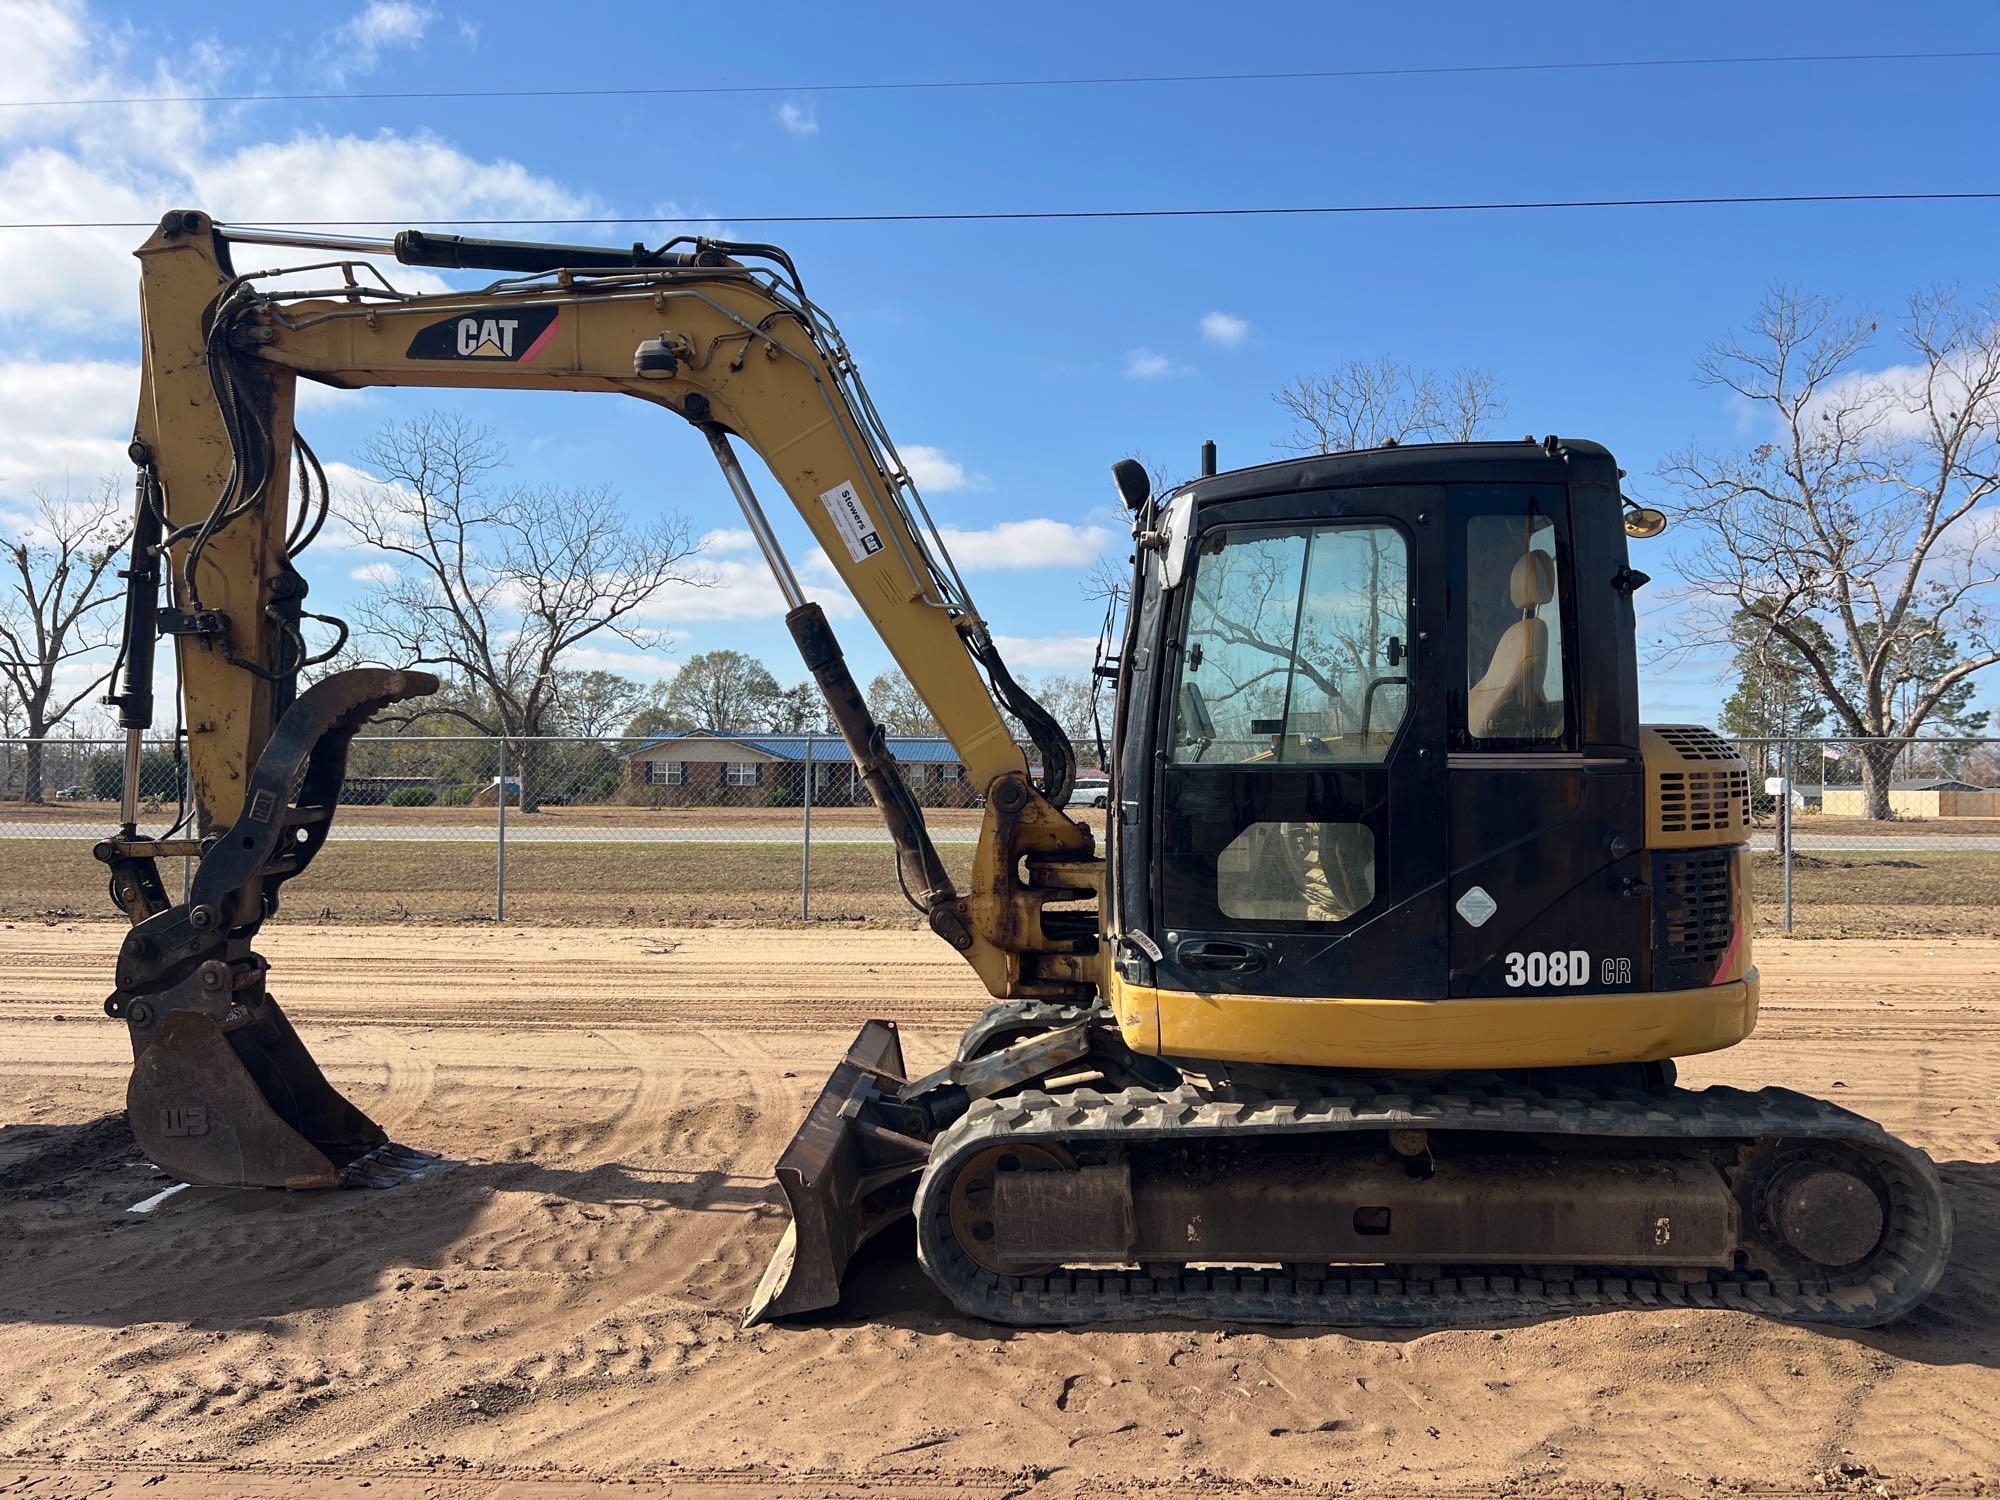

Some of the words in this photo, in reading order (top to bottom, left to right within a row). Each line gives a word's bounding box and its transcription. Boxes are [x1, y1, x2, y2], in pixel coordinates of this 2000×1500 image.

[457, 318, 519, 357] CAT
[841, 490, 866, 530] Stowers
[864, 535, 880, 553] CAT
[1505, 950, 1590, 987] 308D
[1601, 957, 1632, 984] CR
